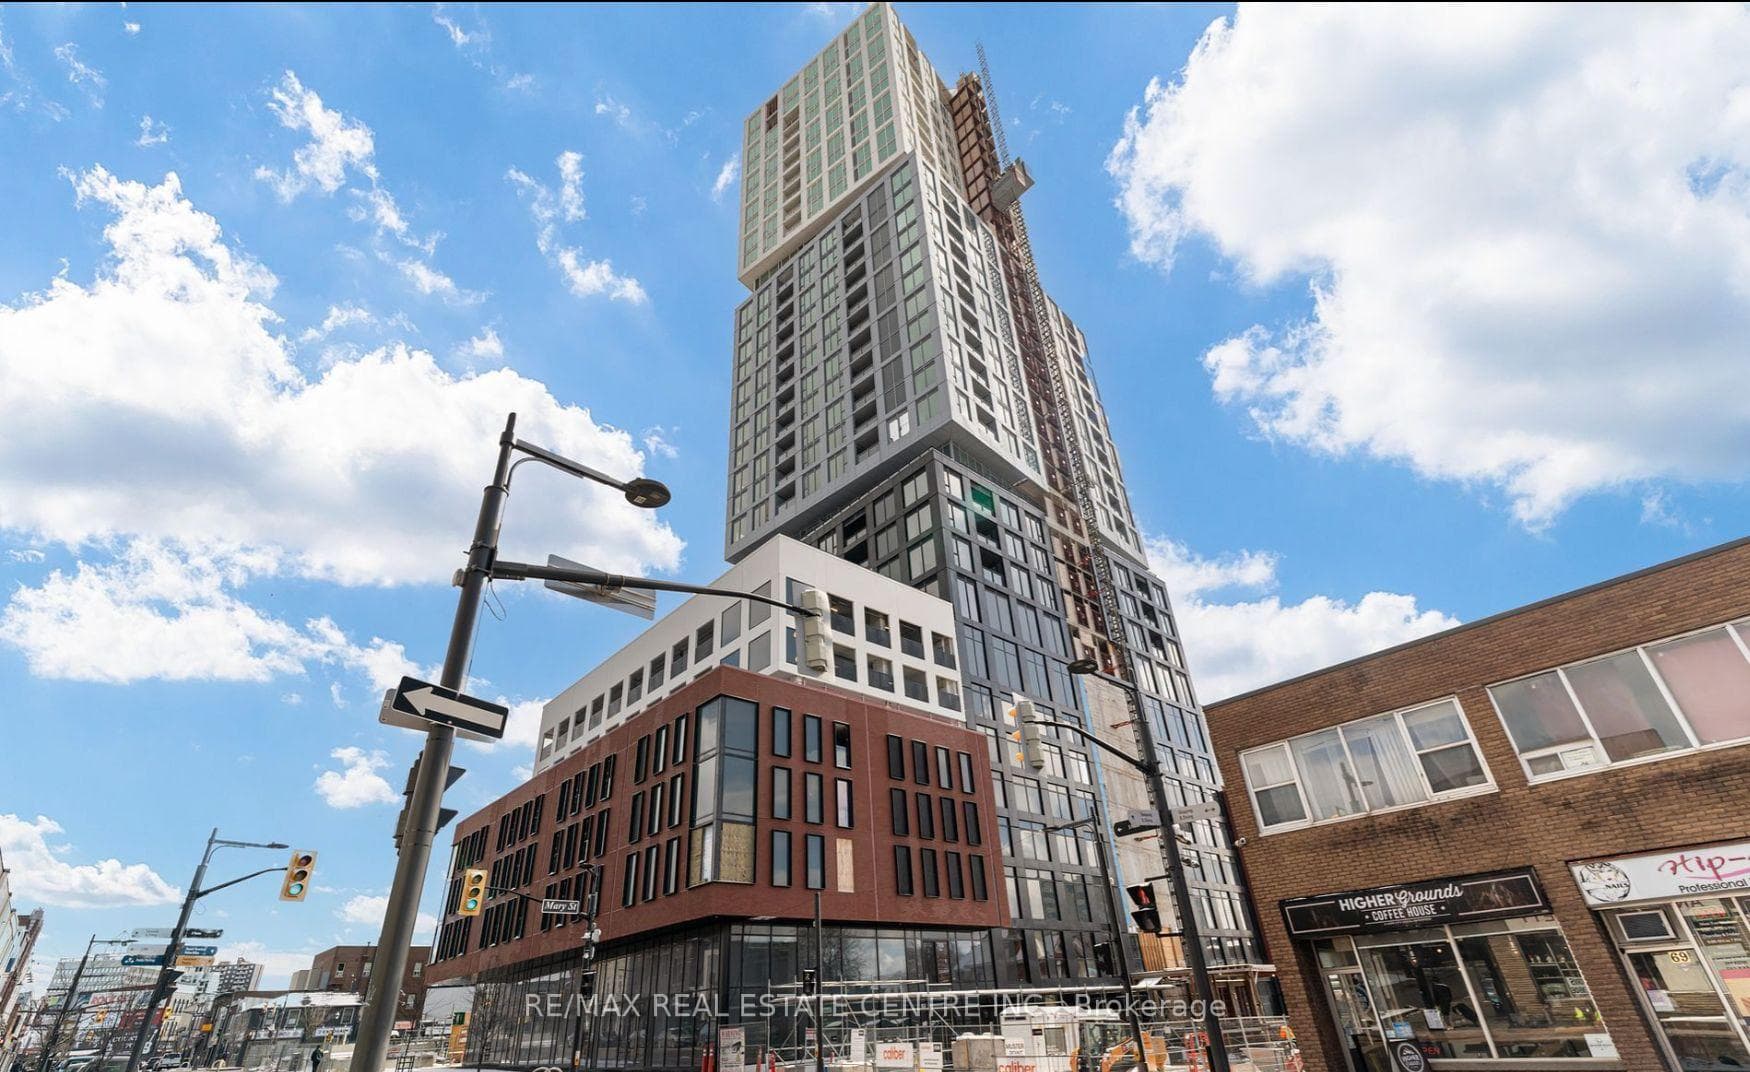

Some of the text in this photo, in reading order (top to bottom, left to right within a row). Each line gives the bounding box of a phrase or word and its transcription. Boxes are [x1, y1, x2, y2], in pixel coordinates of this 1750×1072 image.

[1678, 879, 1748, 893] Professional
[1338, 883, 1463, 911] HIGHER Grounds
[544, 901, 577, 911] Mary St
[1371, 904, 1437, 921] COFFEE HOUSE
[1671, 952, 1688, 962] 69
[883, 1048, 905, 1060] caliber
[1422, 1046, 1440, 1055] PEN
